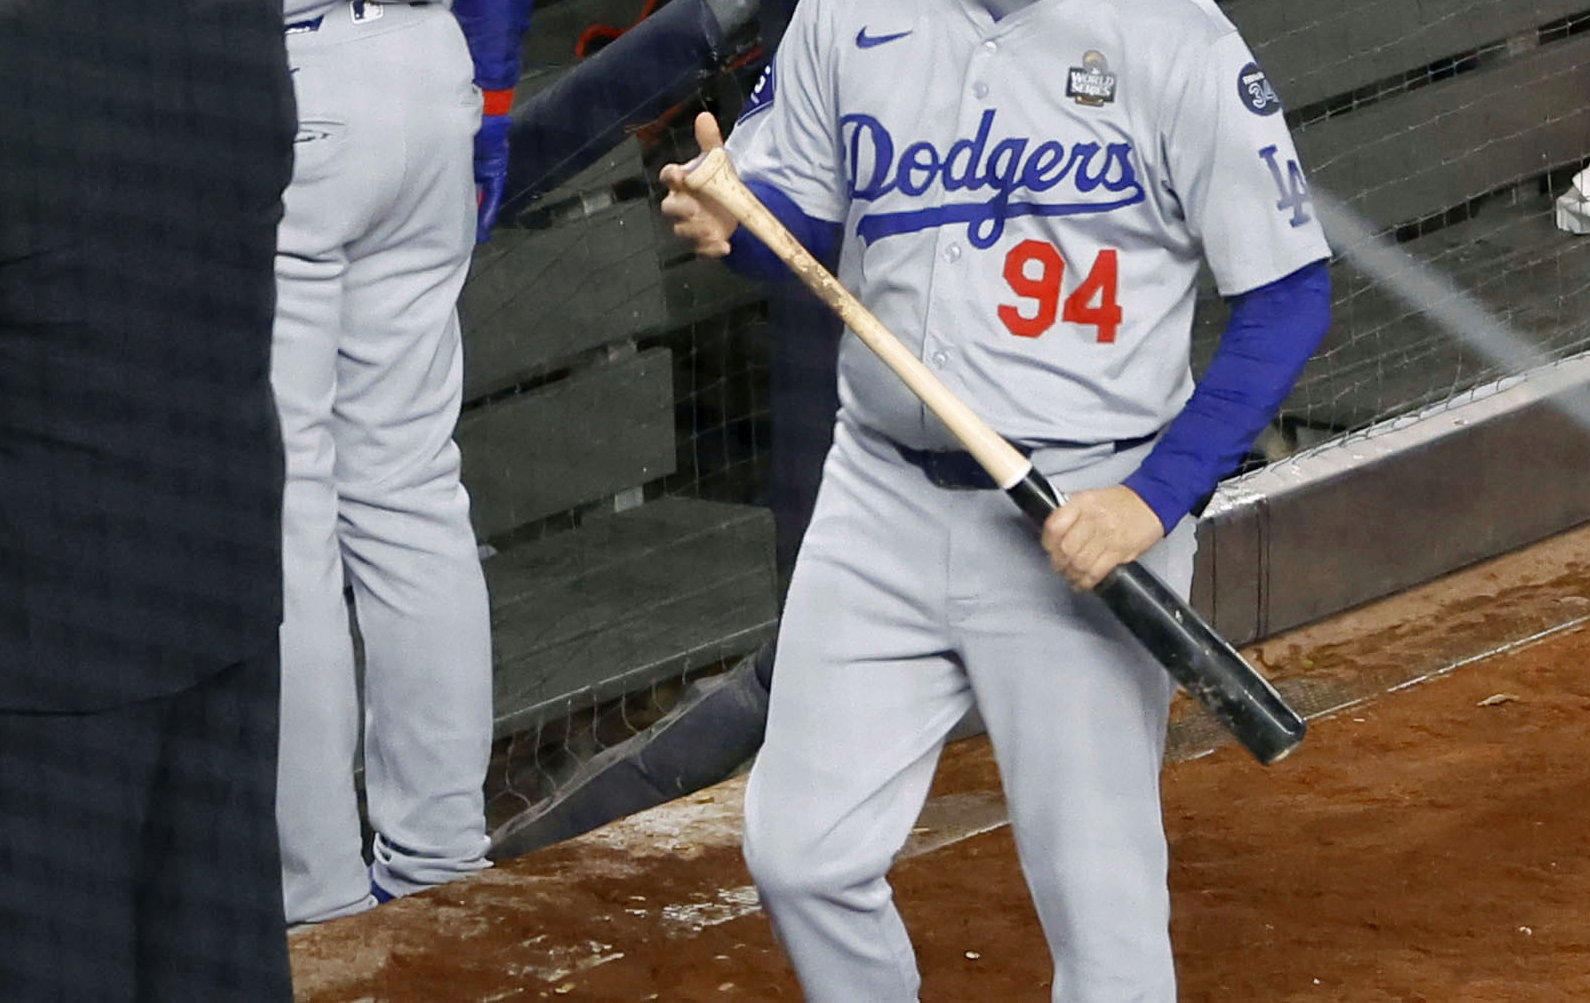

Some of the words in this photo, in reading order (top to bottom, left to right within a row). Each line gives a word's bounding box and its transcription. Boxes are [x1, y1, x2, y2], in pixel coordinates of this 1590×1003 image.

[1070, 69, 1116, 86] WORLD
[1070, 80, 1112, 96] SERIES
[839, 109, 1146, 250] Dodgers
[1258, 144, 1312, 229] LA
[997, 238, 1123, 344] 94
